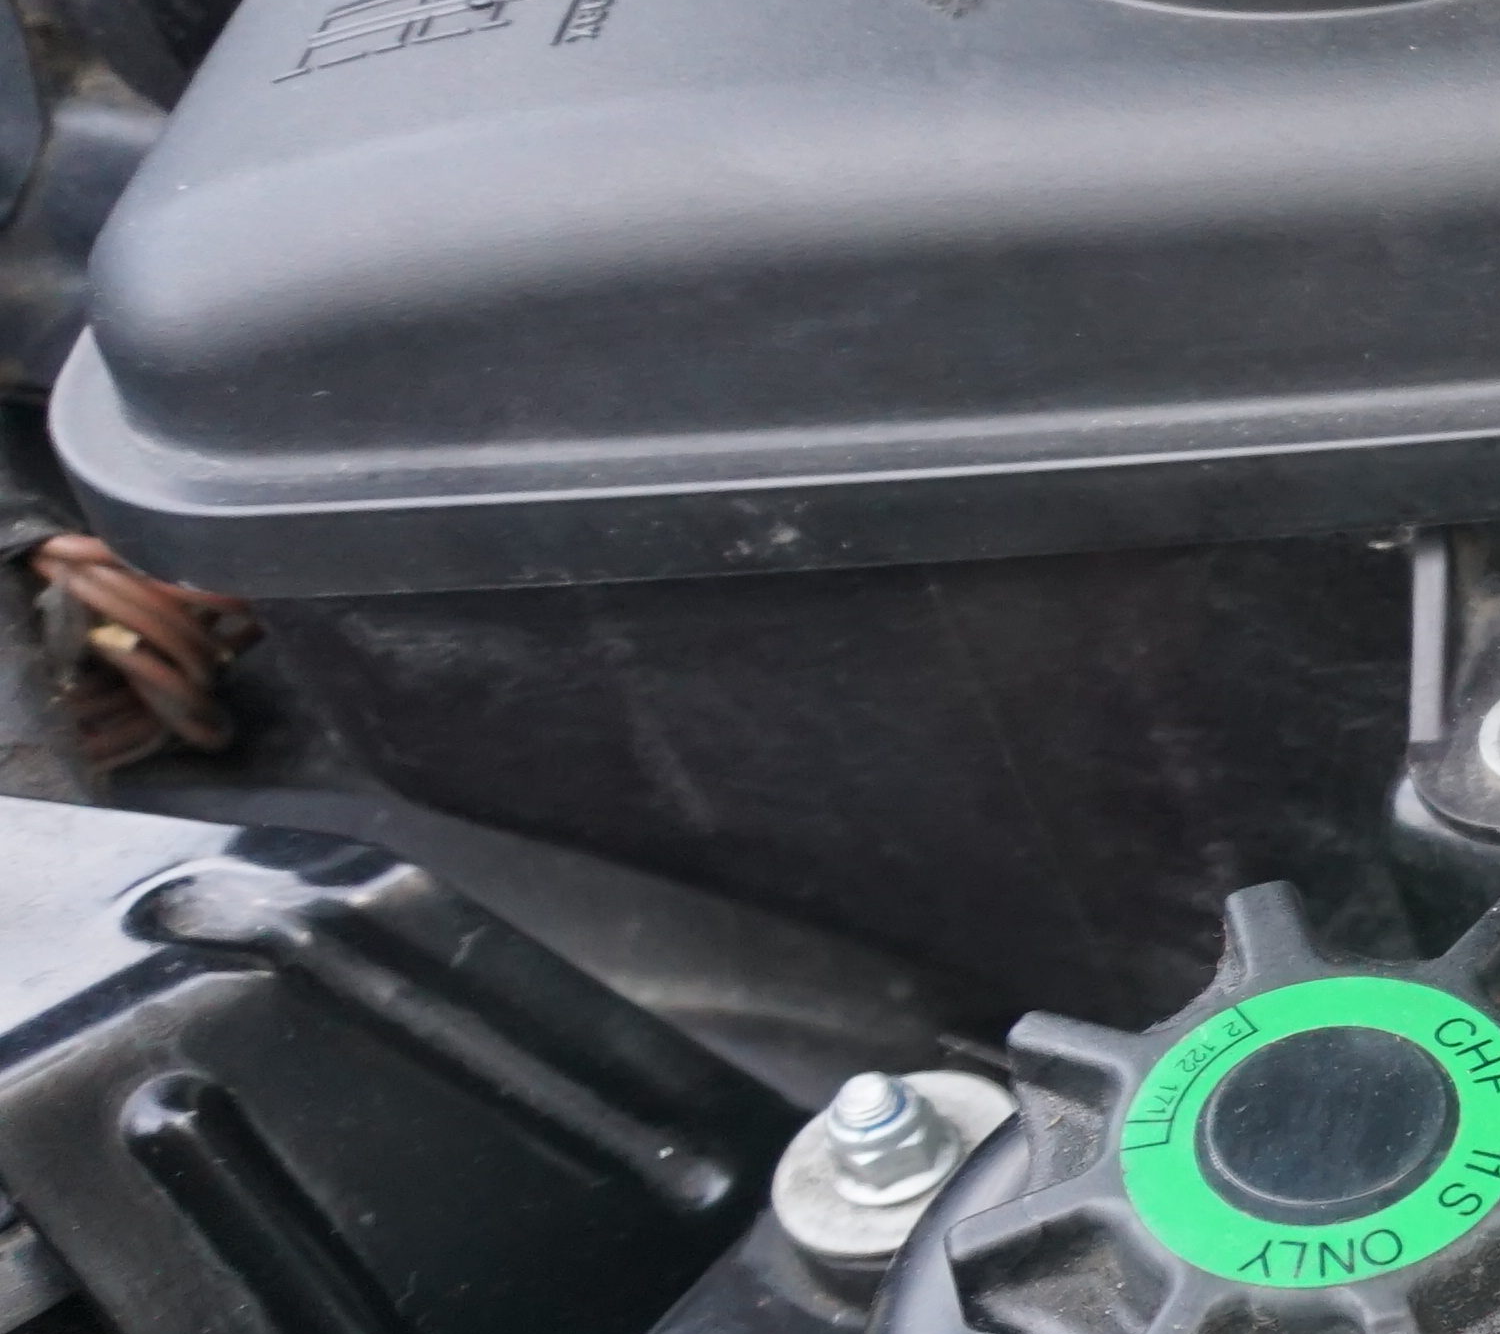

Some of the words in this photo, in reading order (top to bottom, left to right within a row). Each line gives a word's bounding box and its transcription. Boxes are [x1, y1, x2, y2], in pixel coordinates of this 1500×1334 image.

[1221, 1020, 1242, 1039] 2
[1174, 1041, 1217, 1075] 122
[1236, 1228, 1404, 1279] ONLY
